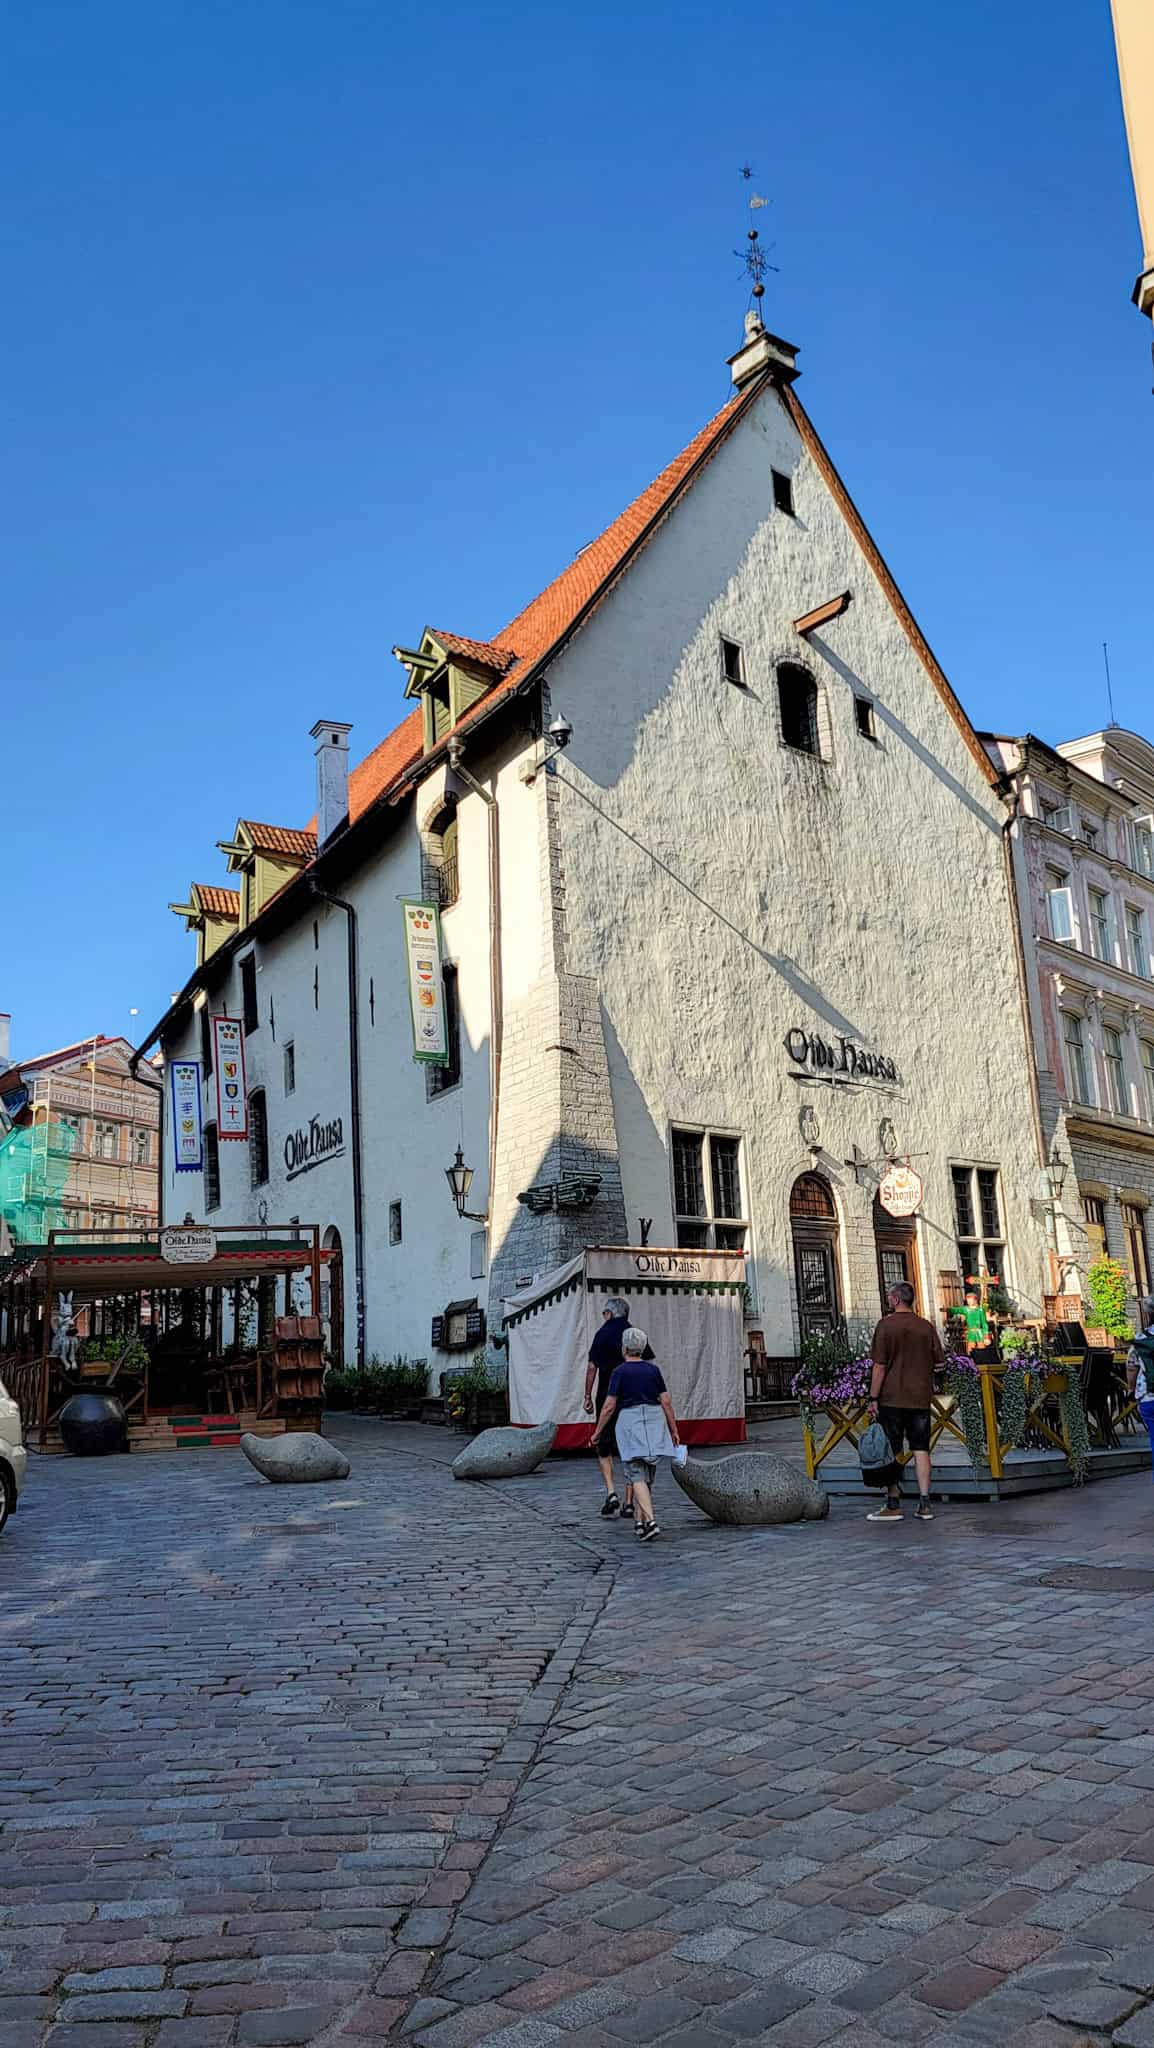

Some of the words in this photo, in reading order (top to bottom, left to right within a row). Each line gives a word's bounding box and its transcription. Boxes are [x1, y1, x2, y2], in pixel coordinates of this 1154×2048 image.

[783, 1028, 835, 1070] Olde
[284, 1128, 309, 1171] Olde
[635, 1254, 666, 1273] Olde
[667, 1255, 701, 1273] Hansa
